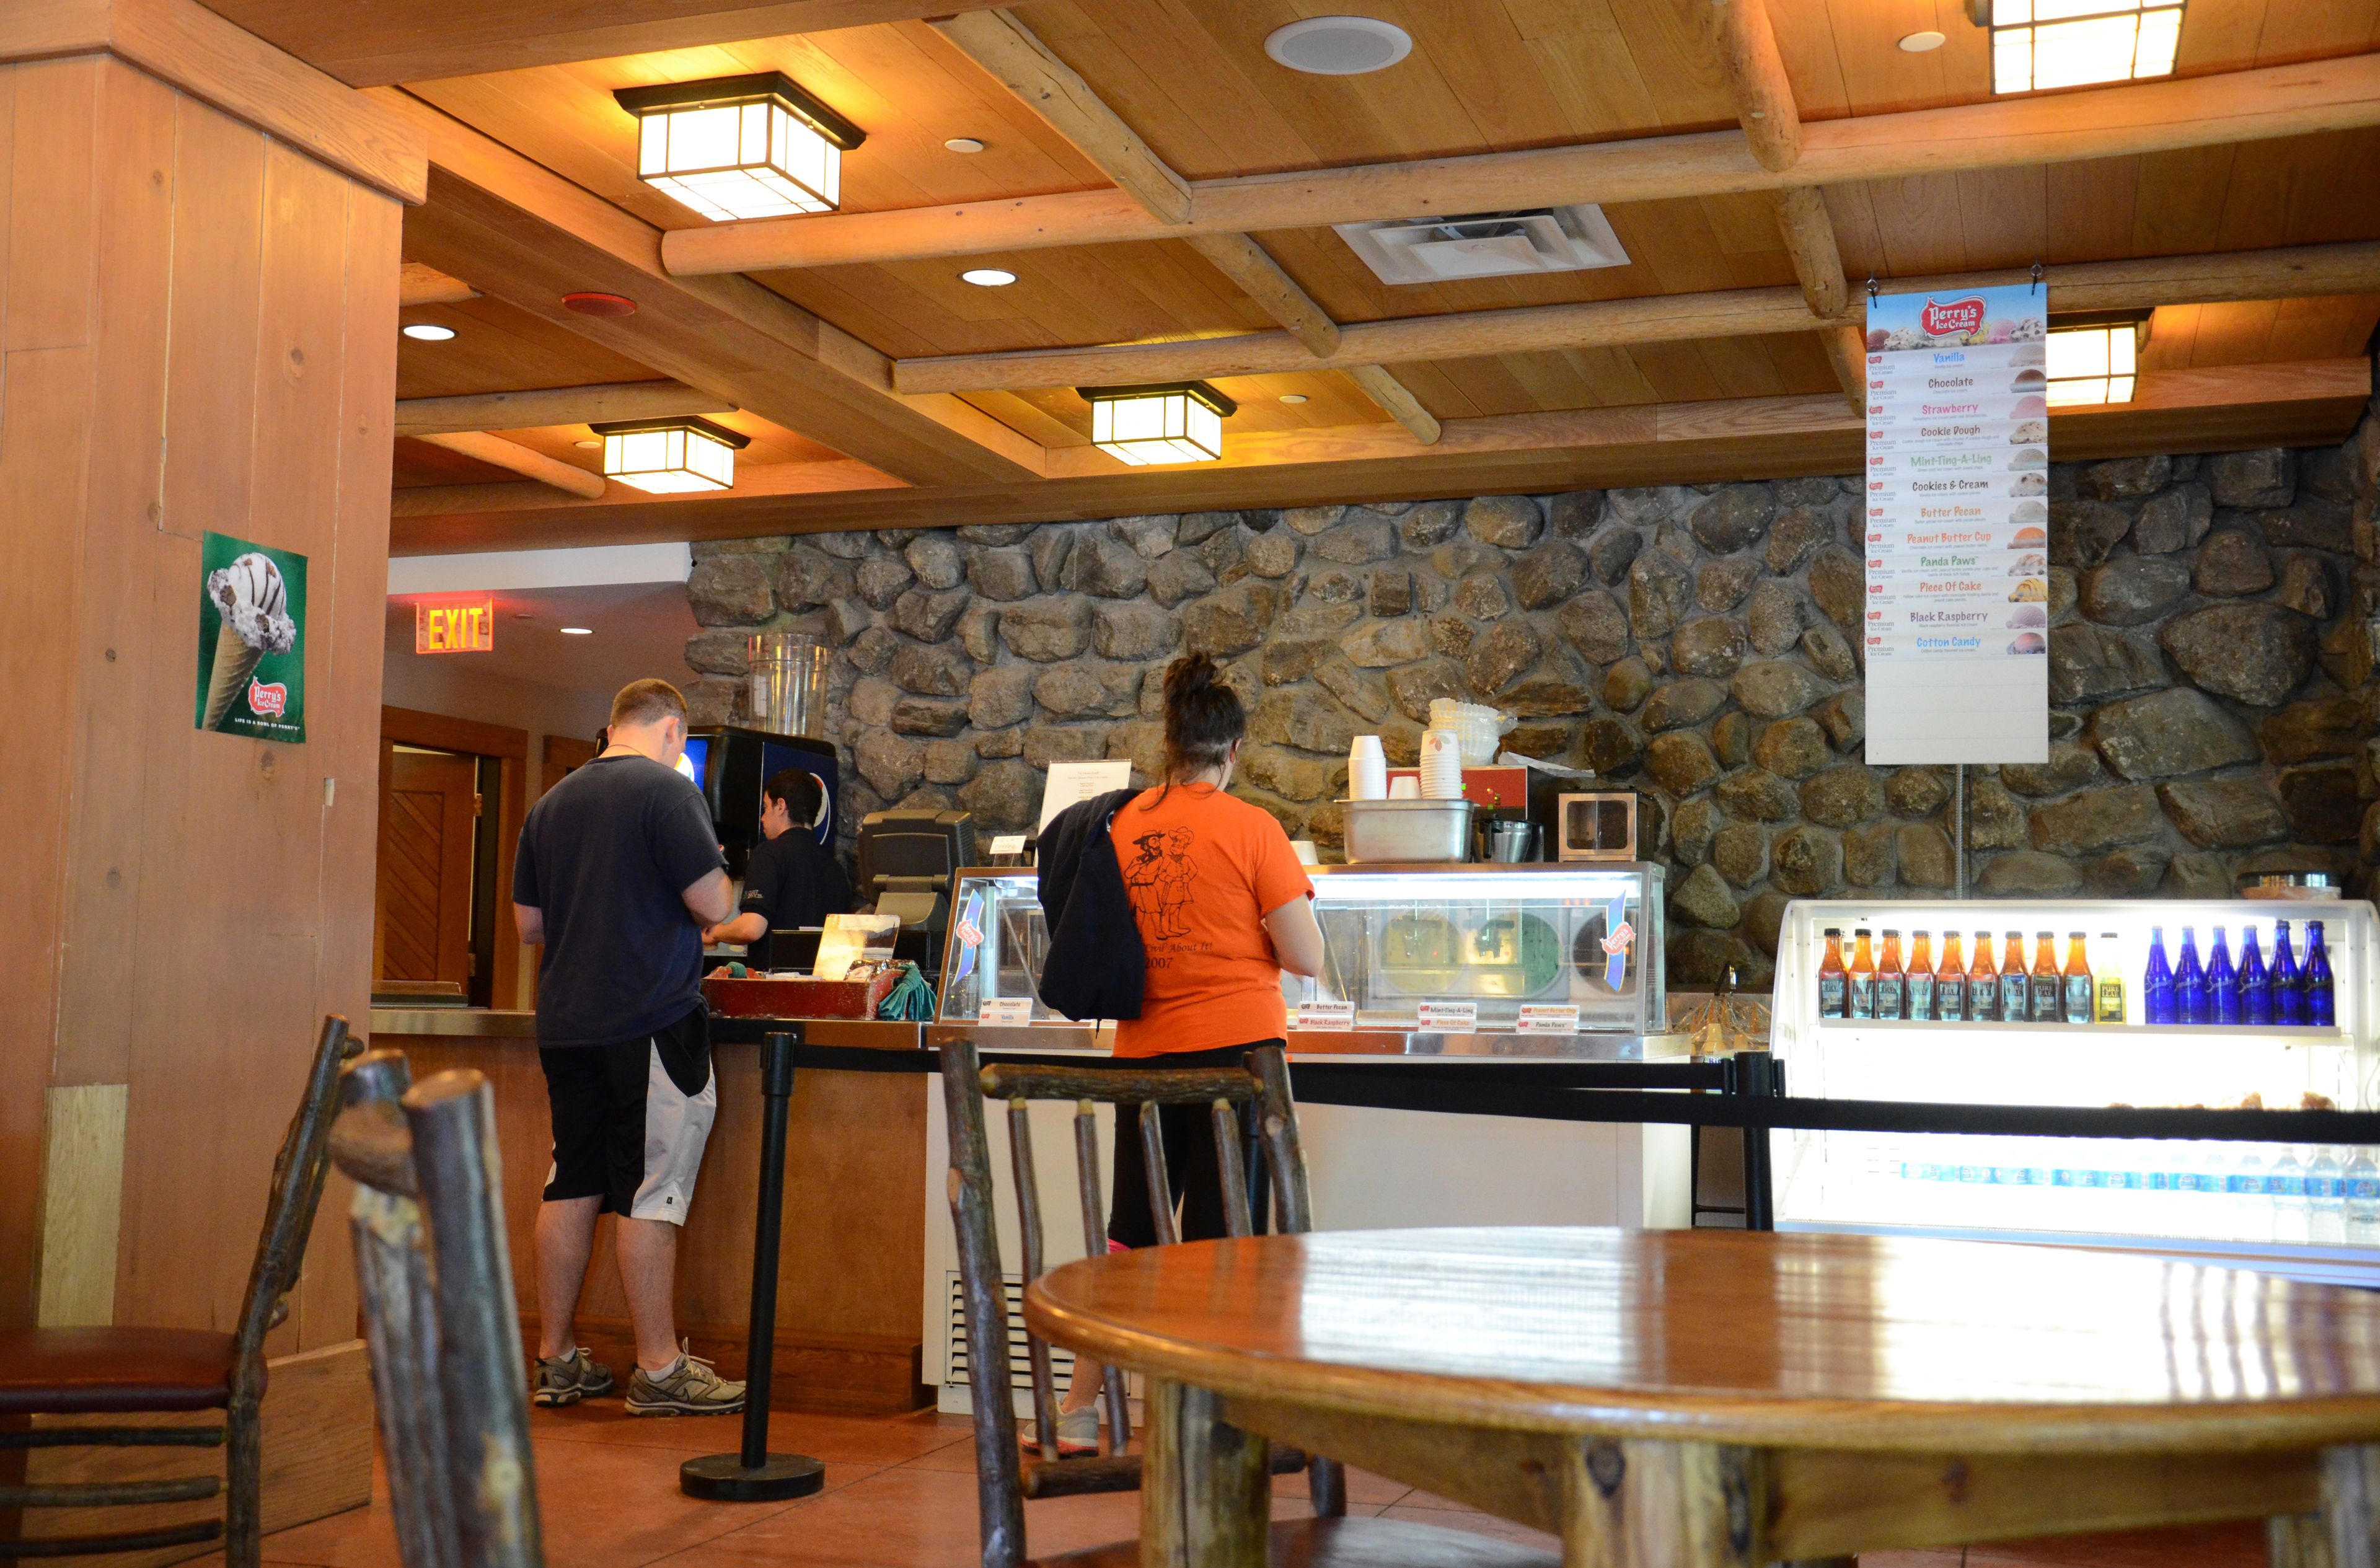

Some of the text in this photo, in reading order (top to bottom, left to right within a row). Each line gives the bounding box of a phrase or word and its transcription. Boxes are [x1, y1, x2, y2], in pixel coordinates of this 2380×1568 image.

[1929, 306, 1977, 326] Perry's
[1936, 319, 1975, 330] Ice Cream
[1934, 352, 1965, 363] Vanilla
[1929, 377, 1973, 388] Chocolate
[1922, 403, 1978, 415] Strawberry
[1921, 425, 1980, 436] Cookie Dough
[1910, 454, 1992, 466] Mint-Ting-A-Ling
[1913, 480, 1988, 491] Cookies & Cream
[1921, 506, 1981, 518] Butter Pecan
[1907, 532, 1992, 544] Peanut Butter Cup
[1921, 557, 1949, 566] Panda
[1920, 581, 1982, 592] Piece Of Cake
[1910, 611, 1988, 622] Black Raspberry
[429, 607, 483, 650] EXIT
[1916, 636, 1981, 647] Cotton Candy
[254, 686, 281, 703] Perry's
[1169, 943, 1196, 953] About
[1201, 942, 1213, 951] It!
[1145, 957, 1173, 969] 2007
